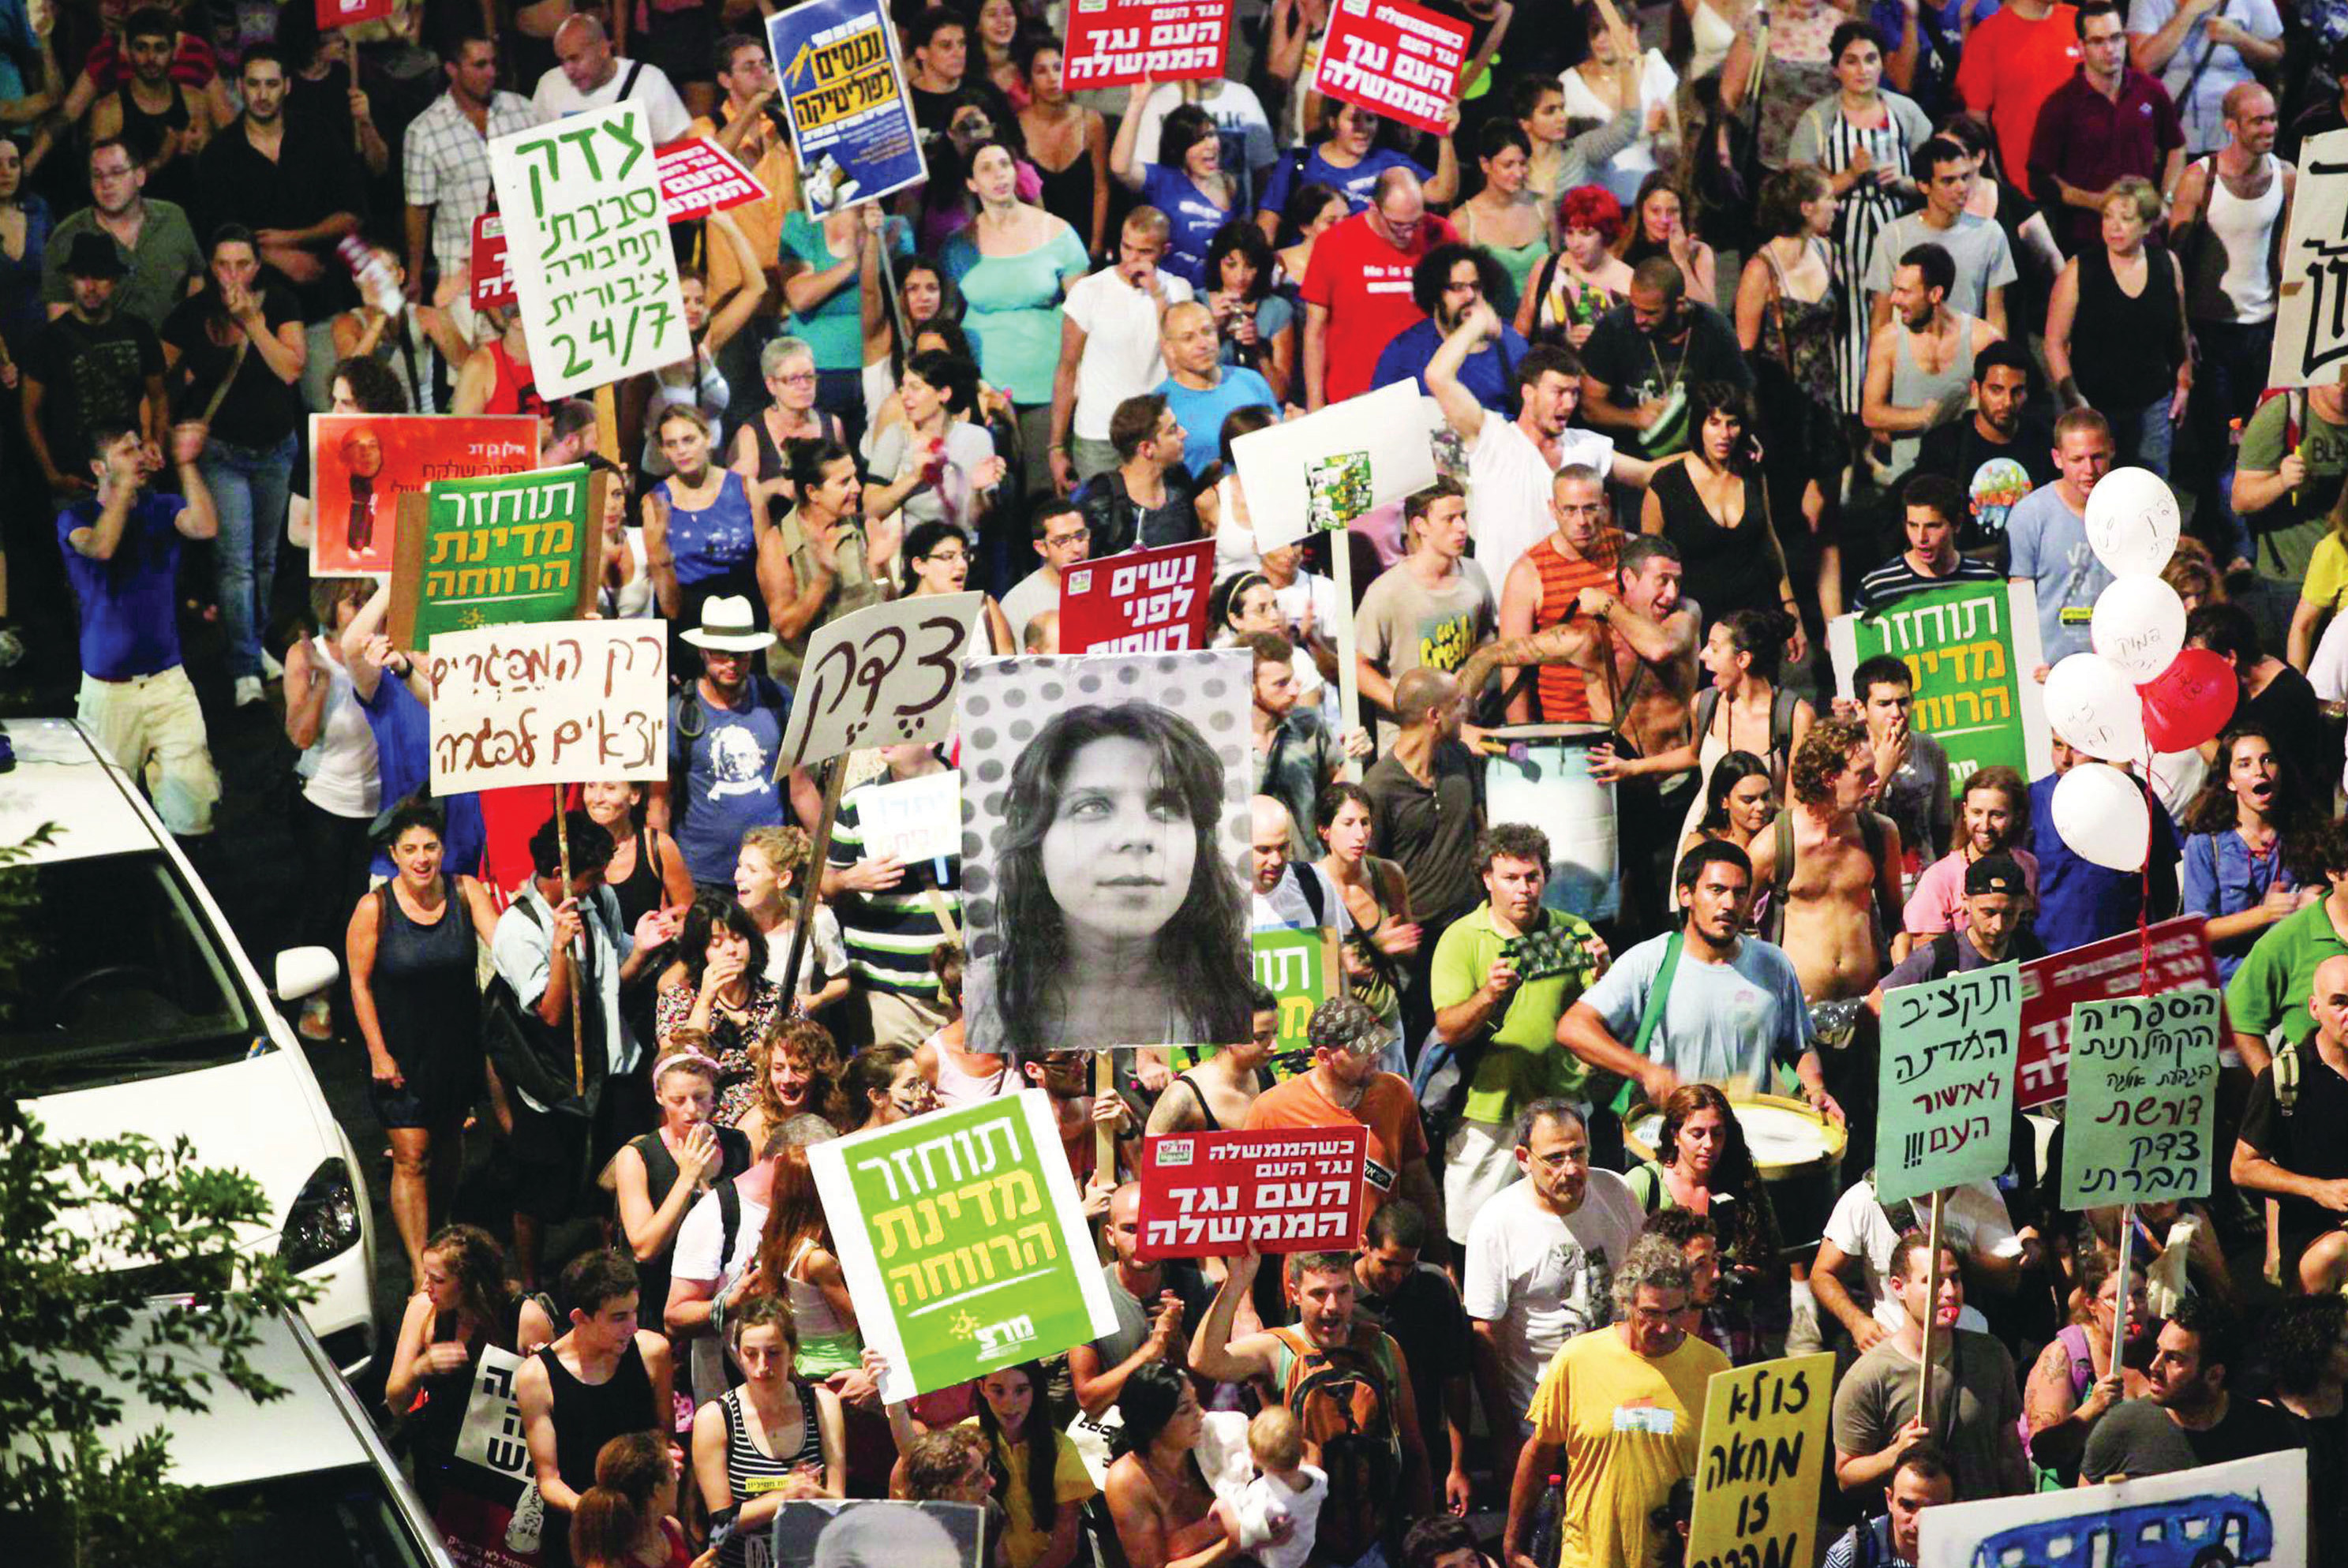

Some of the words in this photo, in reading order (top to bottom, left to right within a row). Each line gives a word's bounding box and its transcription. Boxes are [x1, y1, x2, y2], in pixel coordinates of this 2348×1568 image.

[814, 31, 883, 80] נכנסים
[1087, 27, 1140, 51] נגד
[1150, 21, 1222, 47] העם
[1343, 33, 1388, 71] נגד
[1069, 46, 1218, 79] הממשלה
[1392, 53, 1455, 95] העם
[795, 66, 893, 125] לפוליטיקה
[1321, 58, 1449, 122] הממשלה
[515, 111, 645, 219] צדק
[540, 186, 657, 260] סביבתי
[545, 228, 661, 284] תחבורה
[545, 268, 669, 326] ציבורית
[551, 301, 676, 379] 24/7
[439, 481, 576, 527] תוחזר
[429, 520, 575, 563] מדינת
[426, 559, 571, 597] הרווחה
[1110, 555, 1197, 597] נשים
[1123, 584, 1195, 627] לפני
[1873, 596, 1998, 654] תוחזר
[605, 635, 663, 698] רק
[1903, 638, 2006, 692] מדינ
[1912, 685, 2011, 732] הרוו
[551, 709, 665, 769] יוצאים
[1899, 975, 2011, 1029] תקציב
[2080, 994, 2215, 1032] הספריה
[1894, 1028, 2008, 1085] המדינה
[2080, 1025, 2214, 1068] הקהילתית
[1912, 1071, 2001, 1114] לאישור
[2095, 1095, 2204, 1126] דורשת
[857, 1117, 1022, 1200] תוחזר
[1208, 1140, 1355, 1160] כשהממשלה
[1255, 1162, 1307, 1178] העם
[1314, 1159, 1354, 1174] נגד
[2129, 1130, 2201, 1169] צדק
[1168, 1185, 1239, 1213] נגד
[1255, 1181, 1350, 1209] העם
[2078, 1166, 2199, 1193] חברתי
[872, 1169, 1042, 1259] מדינת
[1146, 1211, 1348, 1246] הממשלה
[888, 1221, 1058, 1306] הרווחה
[1728, 1370, 1769, 1425] לא
[1771, 1370, 1810, 1415] זו
[1706, 1431, 1804, 1492] מחאה
[1736, 1491, 1769, 1539] זו
